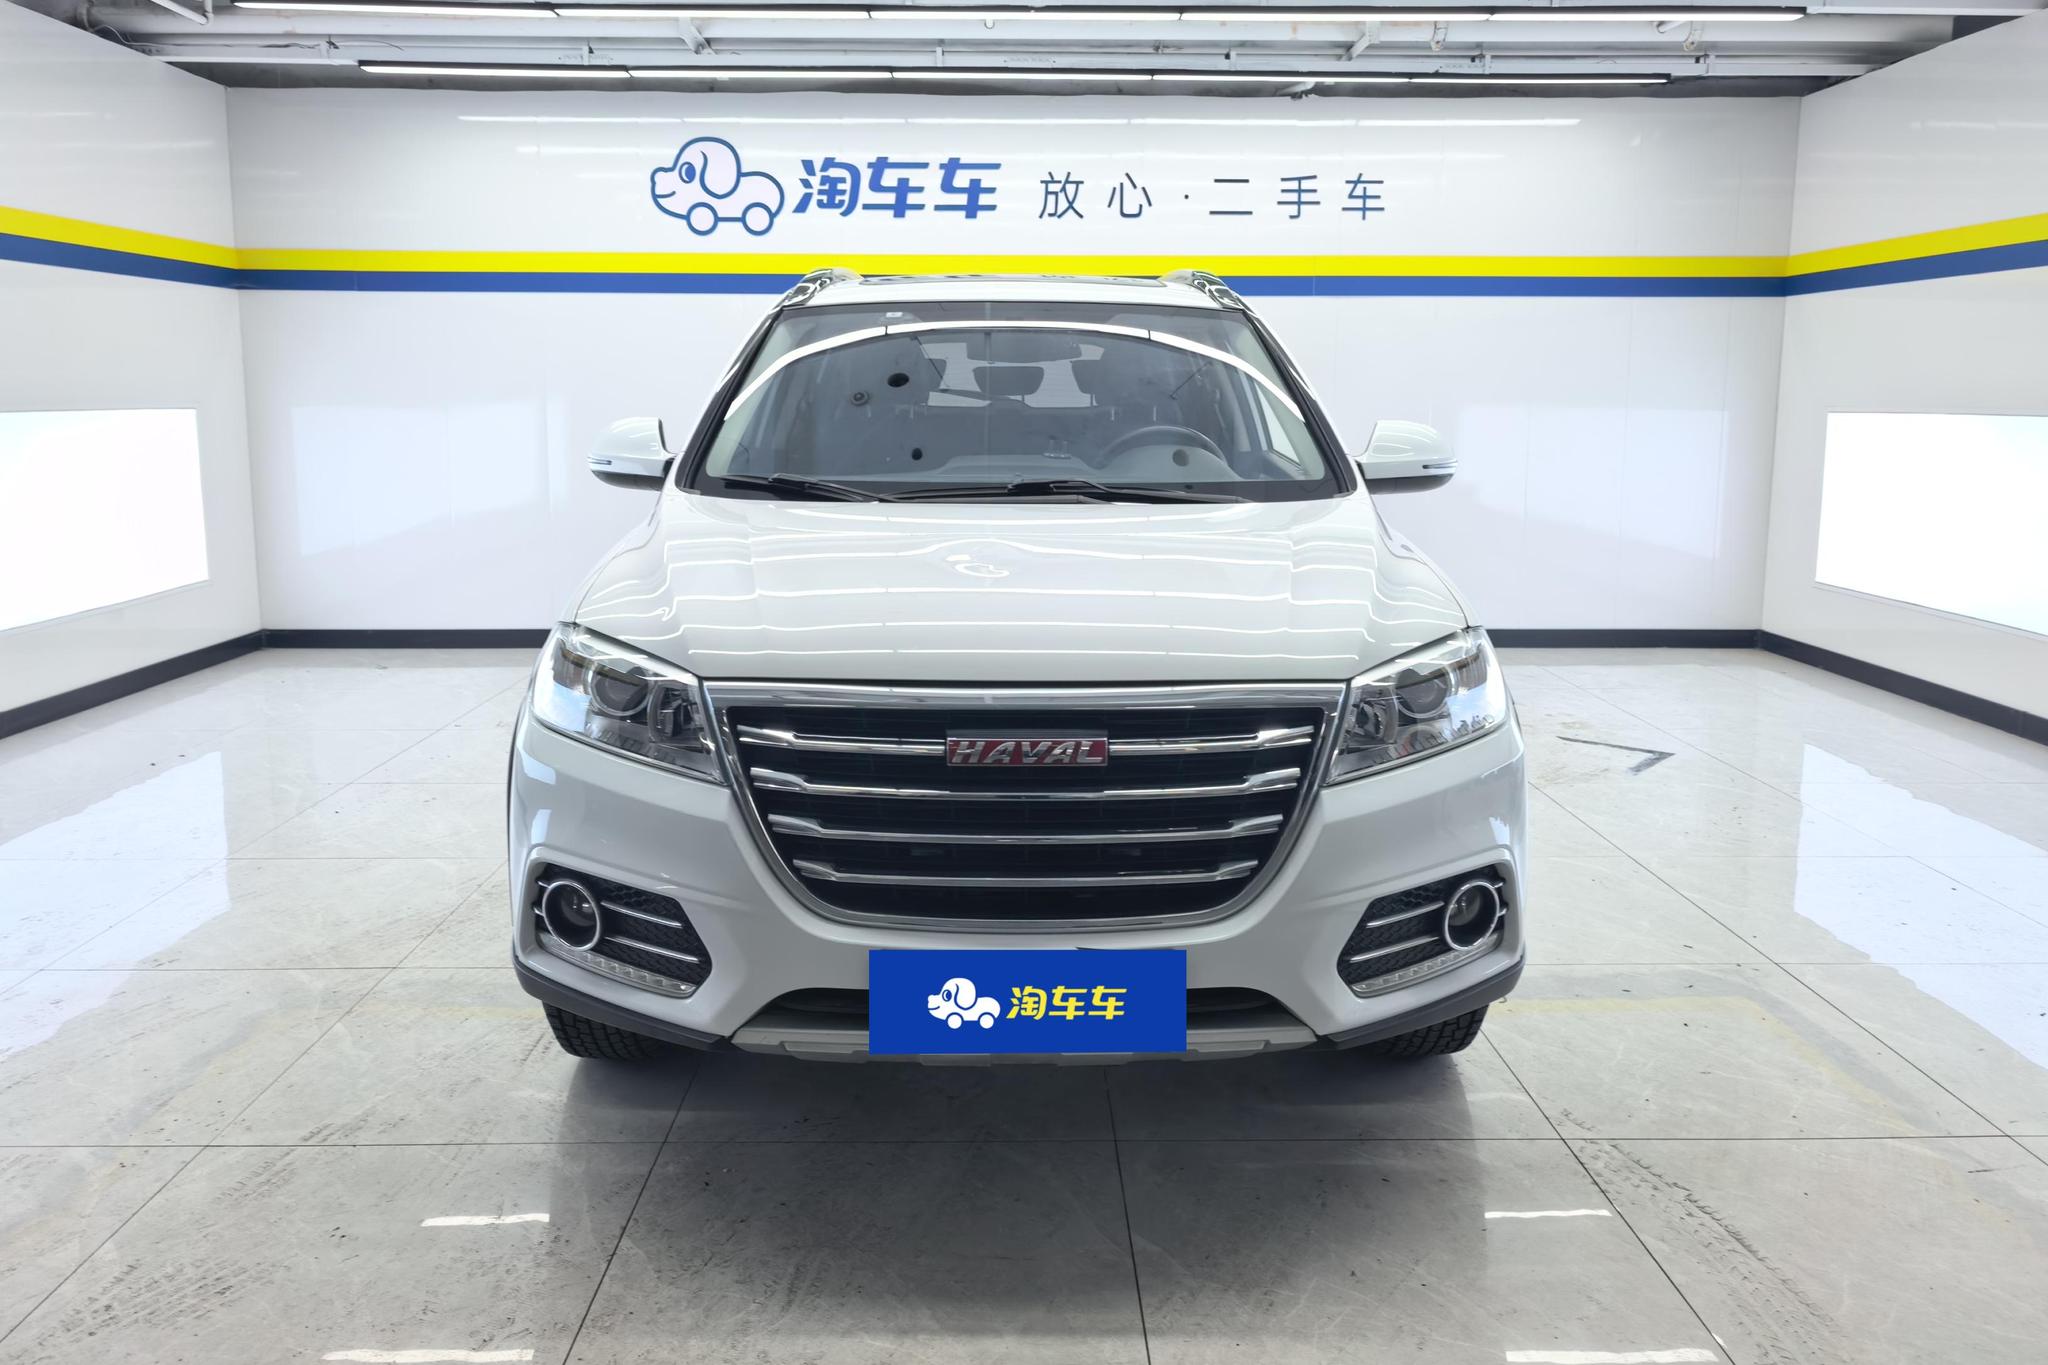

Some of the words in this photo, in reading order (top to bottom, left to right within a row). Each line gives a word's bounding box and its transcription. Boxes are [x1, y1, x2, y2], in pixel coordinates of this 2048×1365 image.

[791, 156, 1002, 219] 淘车车
[951, 740, 1104, 764] HAVAL
